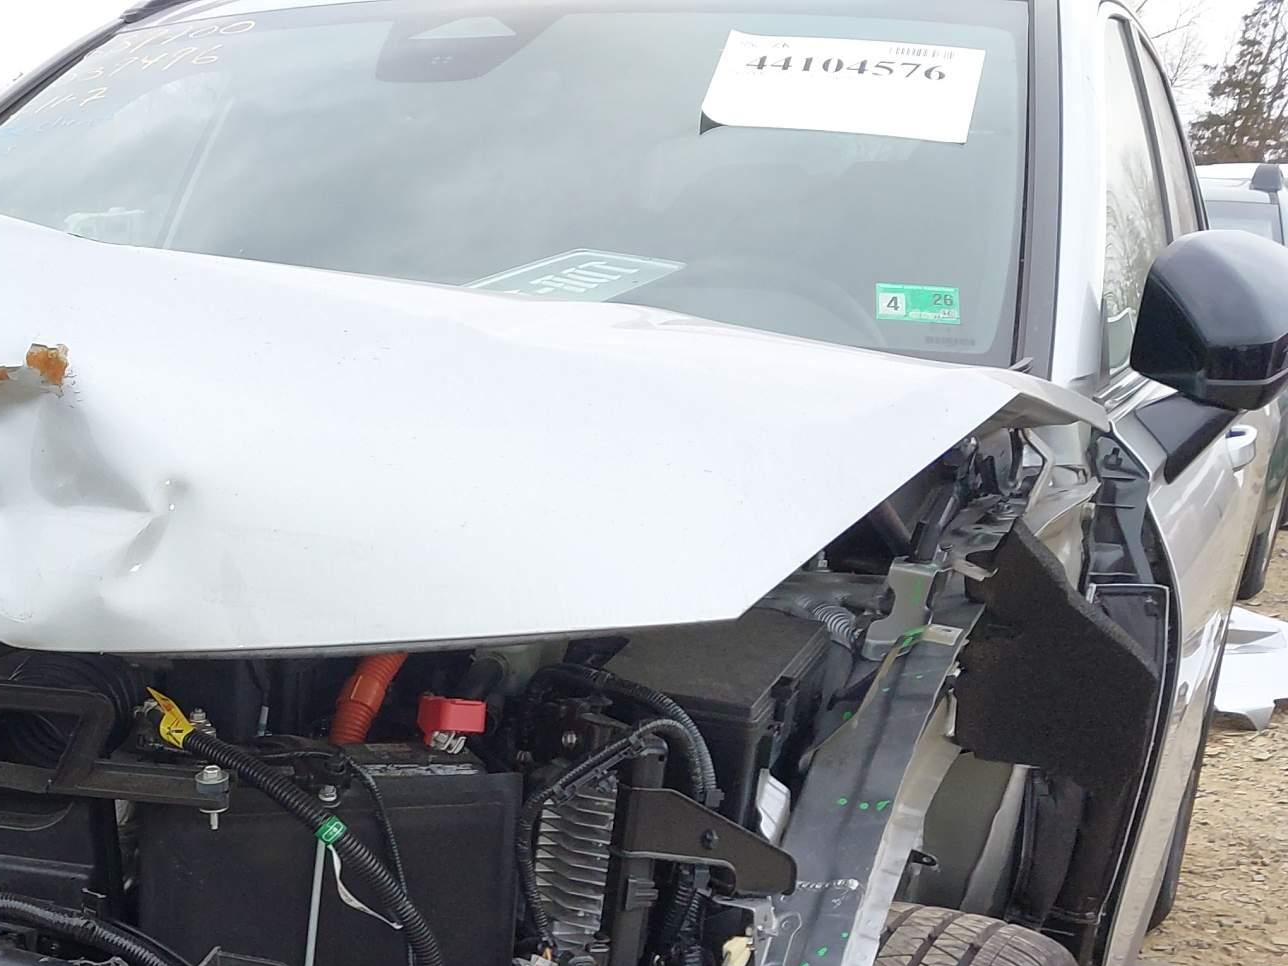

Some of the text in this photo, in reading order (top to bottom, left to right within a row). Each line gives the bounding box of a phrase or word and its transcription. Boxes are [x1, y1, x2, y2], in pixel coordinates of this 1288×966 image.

[745, 54, 947, 81] 44104576
[886, 293, 954, 312] 4 26
